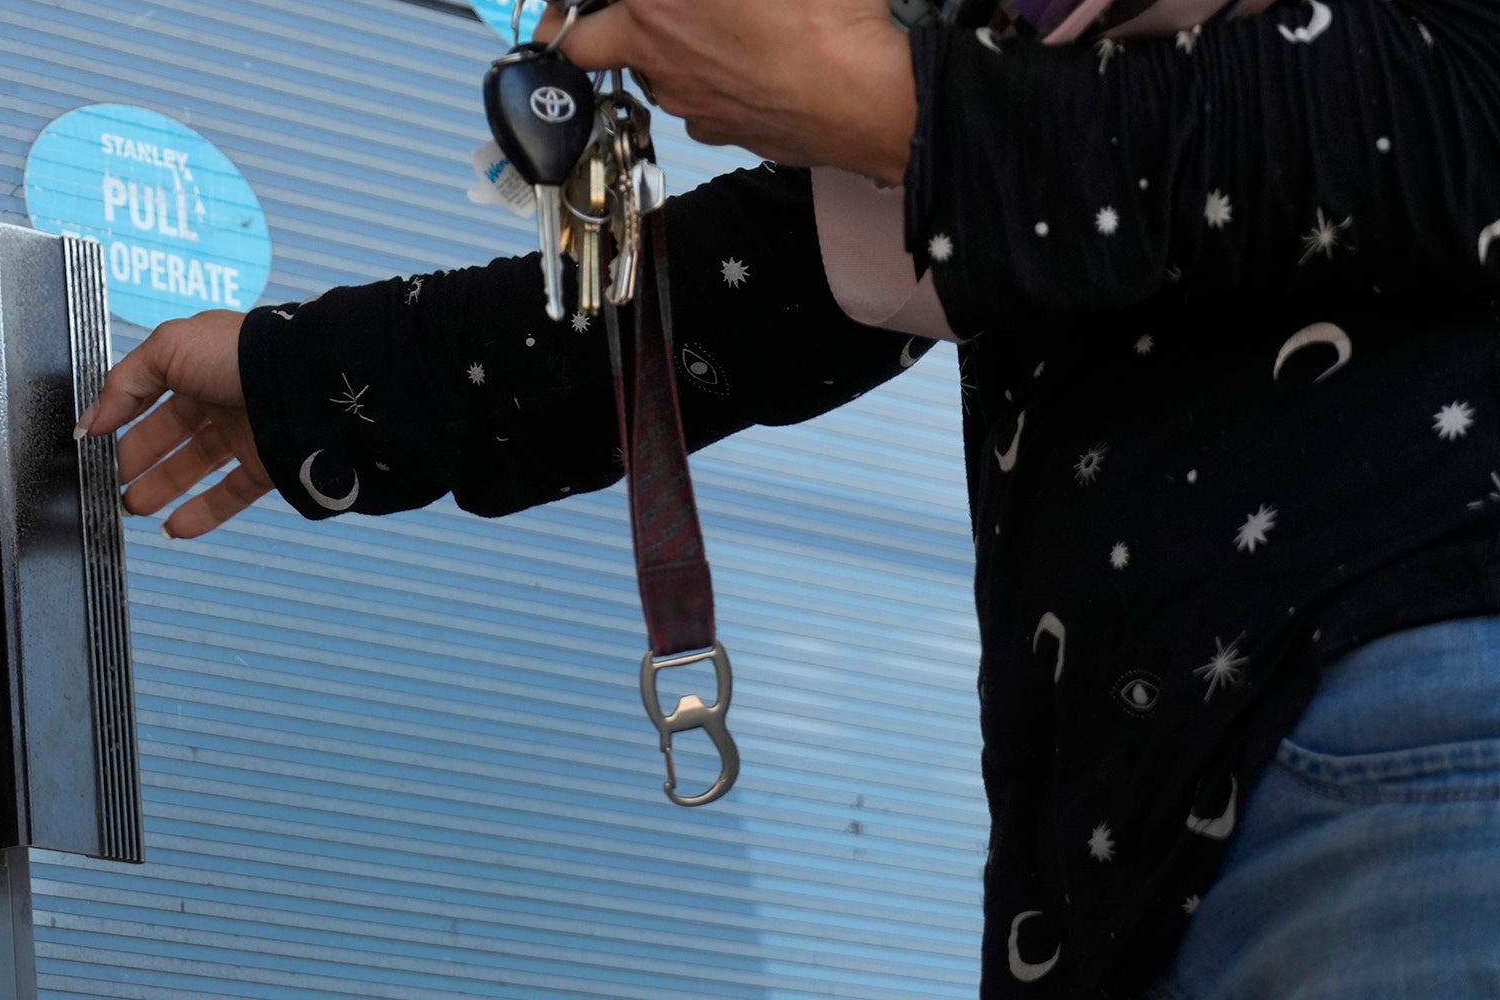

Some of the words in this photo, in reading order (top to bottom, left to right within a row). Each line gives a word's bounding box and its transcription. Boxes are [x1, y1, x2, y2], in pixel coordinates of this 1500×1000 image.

[101, 133, 189, 172] STANLEY
[103, 174, 199, 242] PULL
[109, 241, 242, 308] OPERATE
